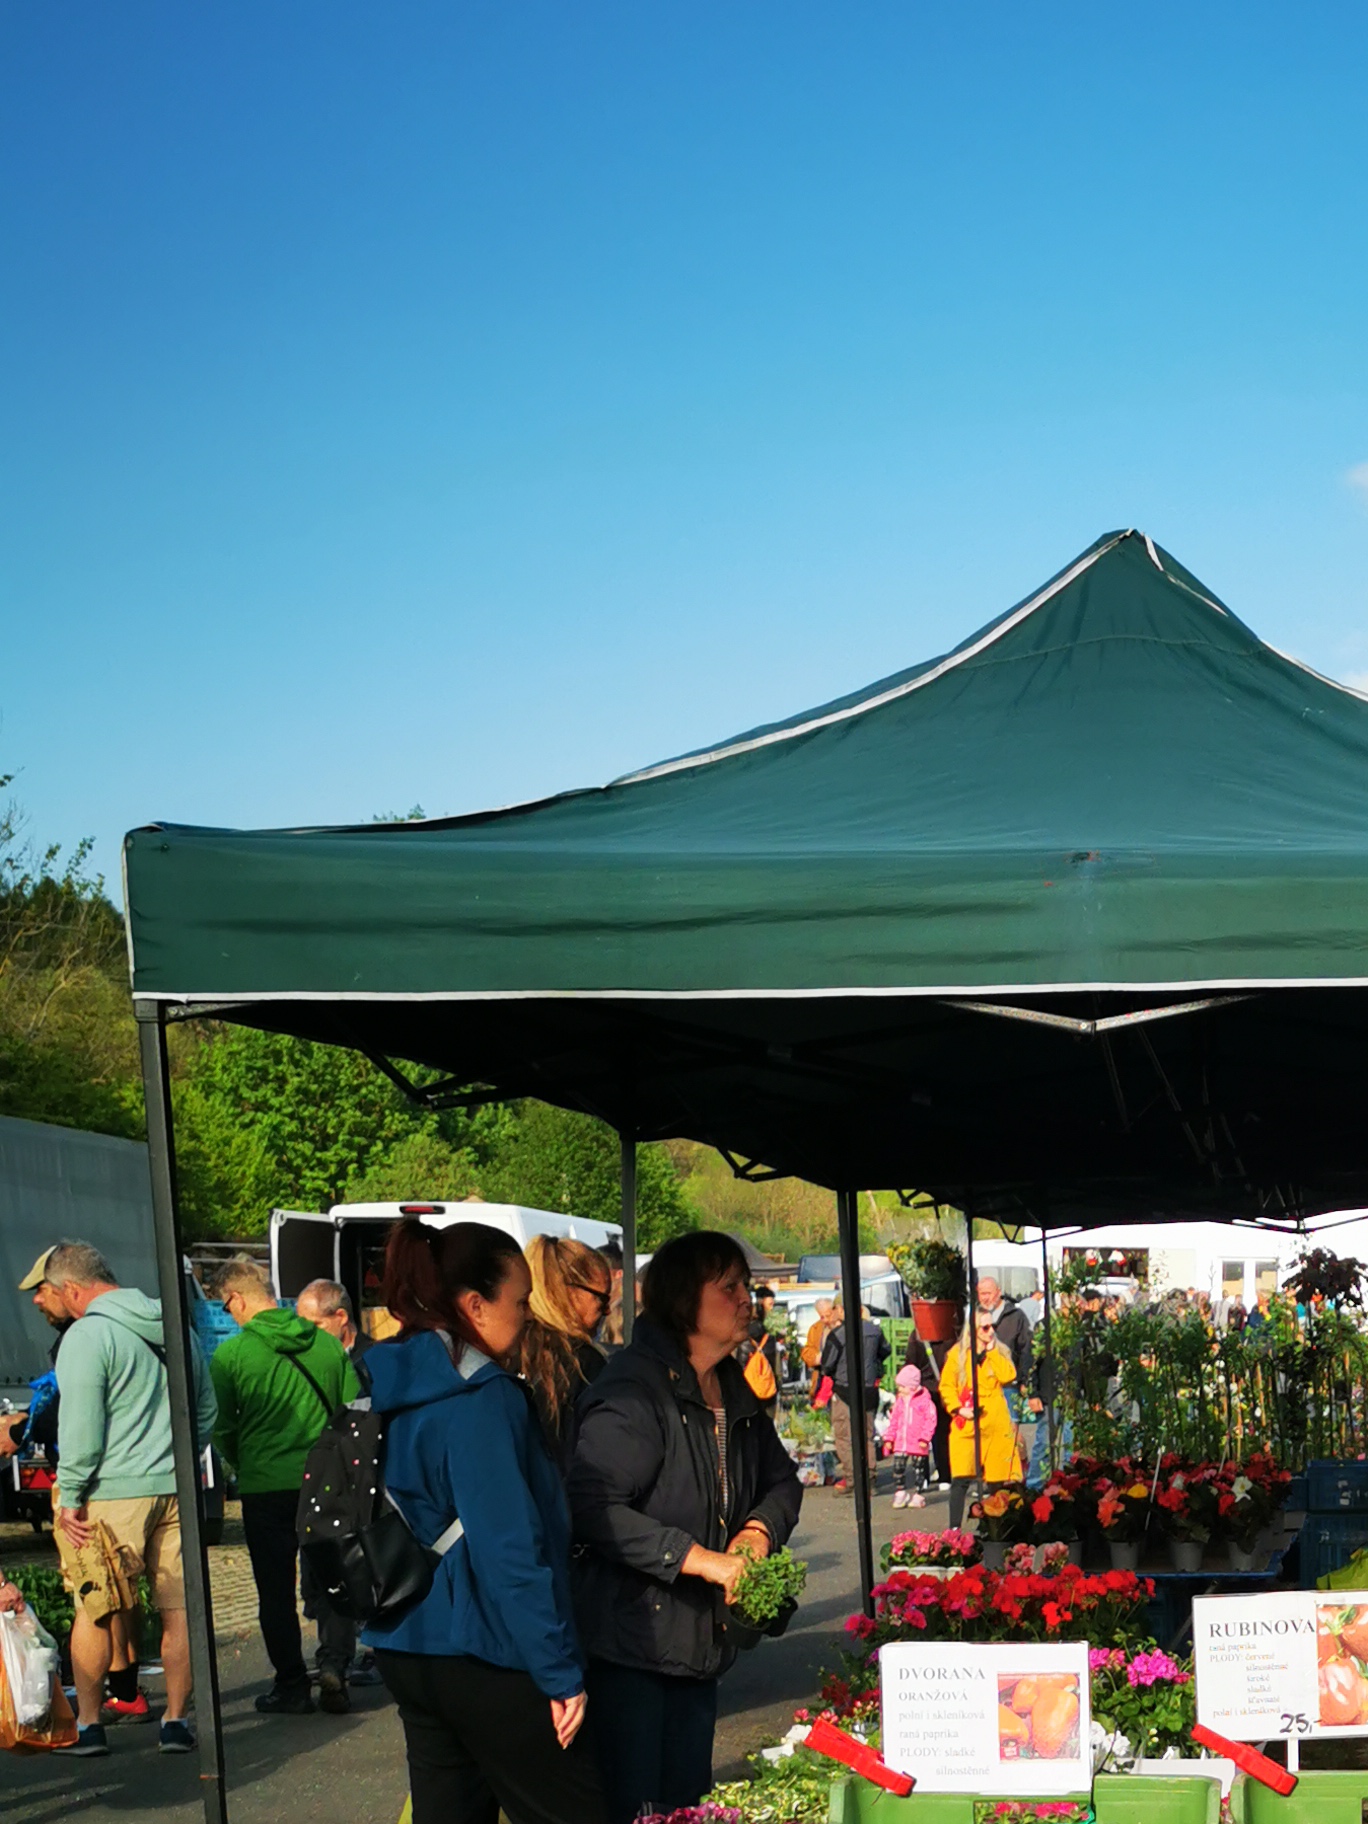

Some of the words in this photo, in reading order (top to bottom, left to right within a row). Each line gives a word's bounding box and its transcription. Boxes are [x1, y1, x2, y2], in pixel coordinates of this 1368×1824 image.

[1209, 1618, 1316, 1638] RUBINOVA
[1228, 1642, 1257, 1653] paprika
[1210, 1653, 1243, 1663] PLODY:
[899, 1667, 986, 1681] DVORANA
[899, 1688, 968, 1701] ORANŽOVÁ
[899, 1711, 924, 1722] polní
[932, 1710, 985, 1720] skleníková
[899, 1730, 920, 1739] raná
[922, 1729, 959, 1740] paprika
[900, 1747, 942, 1757] PLODY:
[944, 1747, 976, 1757] sladké
[936, 1765, 990, 1775] silnostěnné
